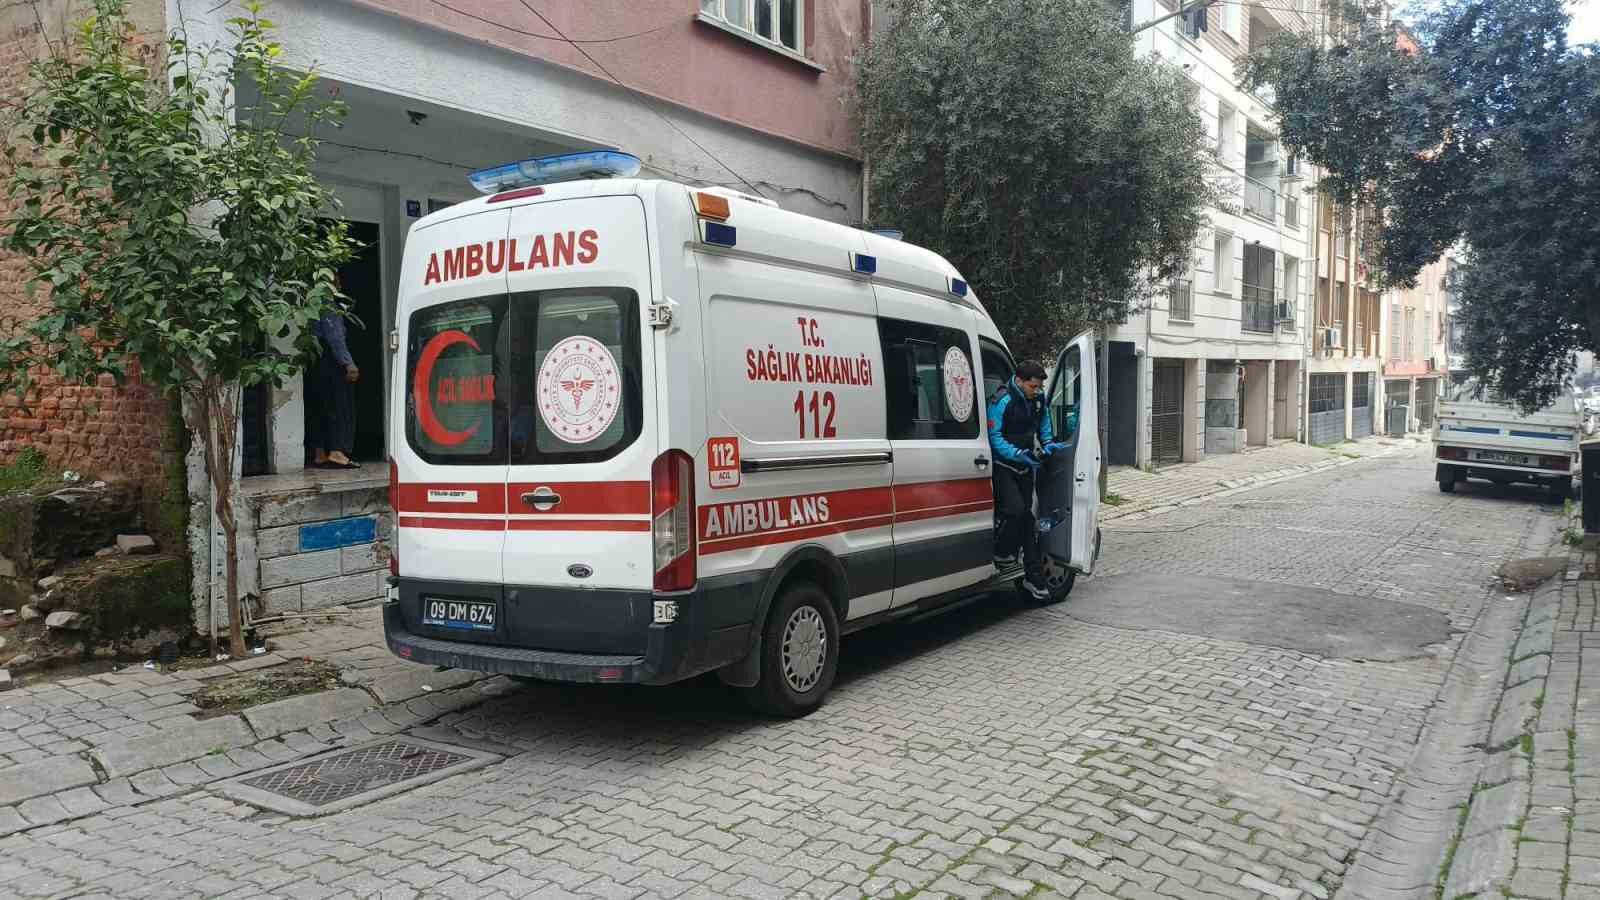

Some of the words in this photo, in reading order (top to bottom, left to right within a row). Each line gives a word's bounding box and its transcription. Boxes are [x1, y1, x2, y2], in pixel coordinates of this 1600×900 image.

[424, 229, 599, 285] AMBULANS
[798, 317, 825, 348] T.C.
[746, 344, 802, 383] SAĞLIK
[806, 353, 873, 386] BAKANLIĞI
[793, 391, 837, 439] 112
[712, 442, 735, 466] 112
[704, 496, 829, 537] AMBULANS
[430, 602, 446, 618] 09
[448, 603, 467, 620] DM
[470, 605, 493, 623] 674
